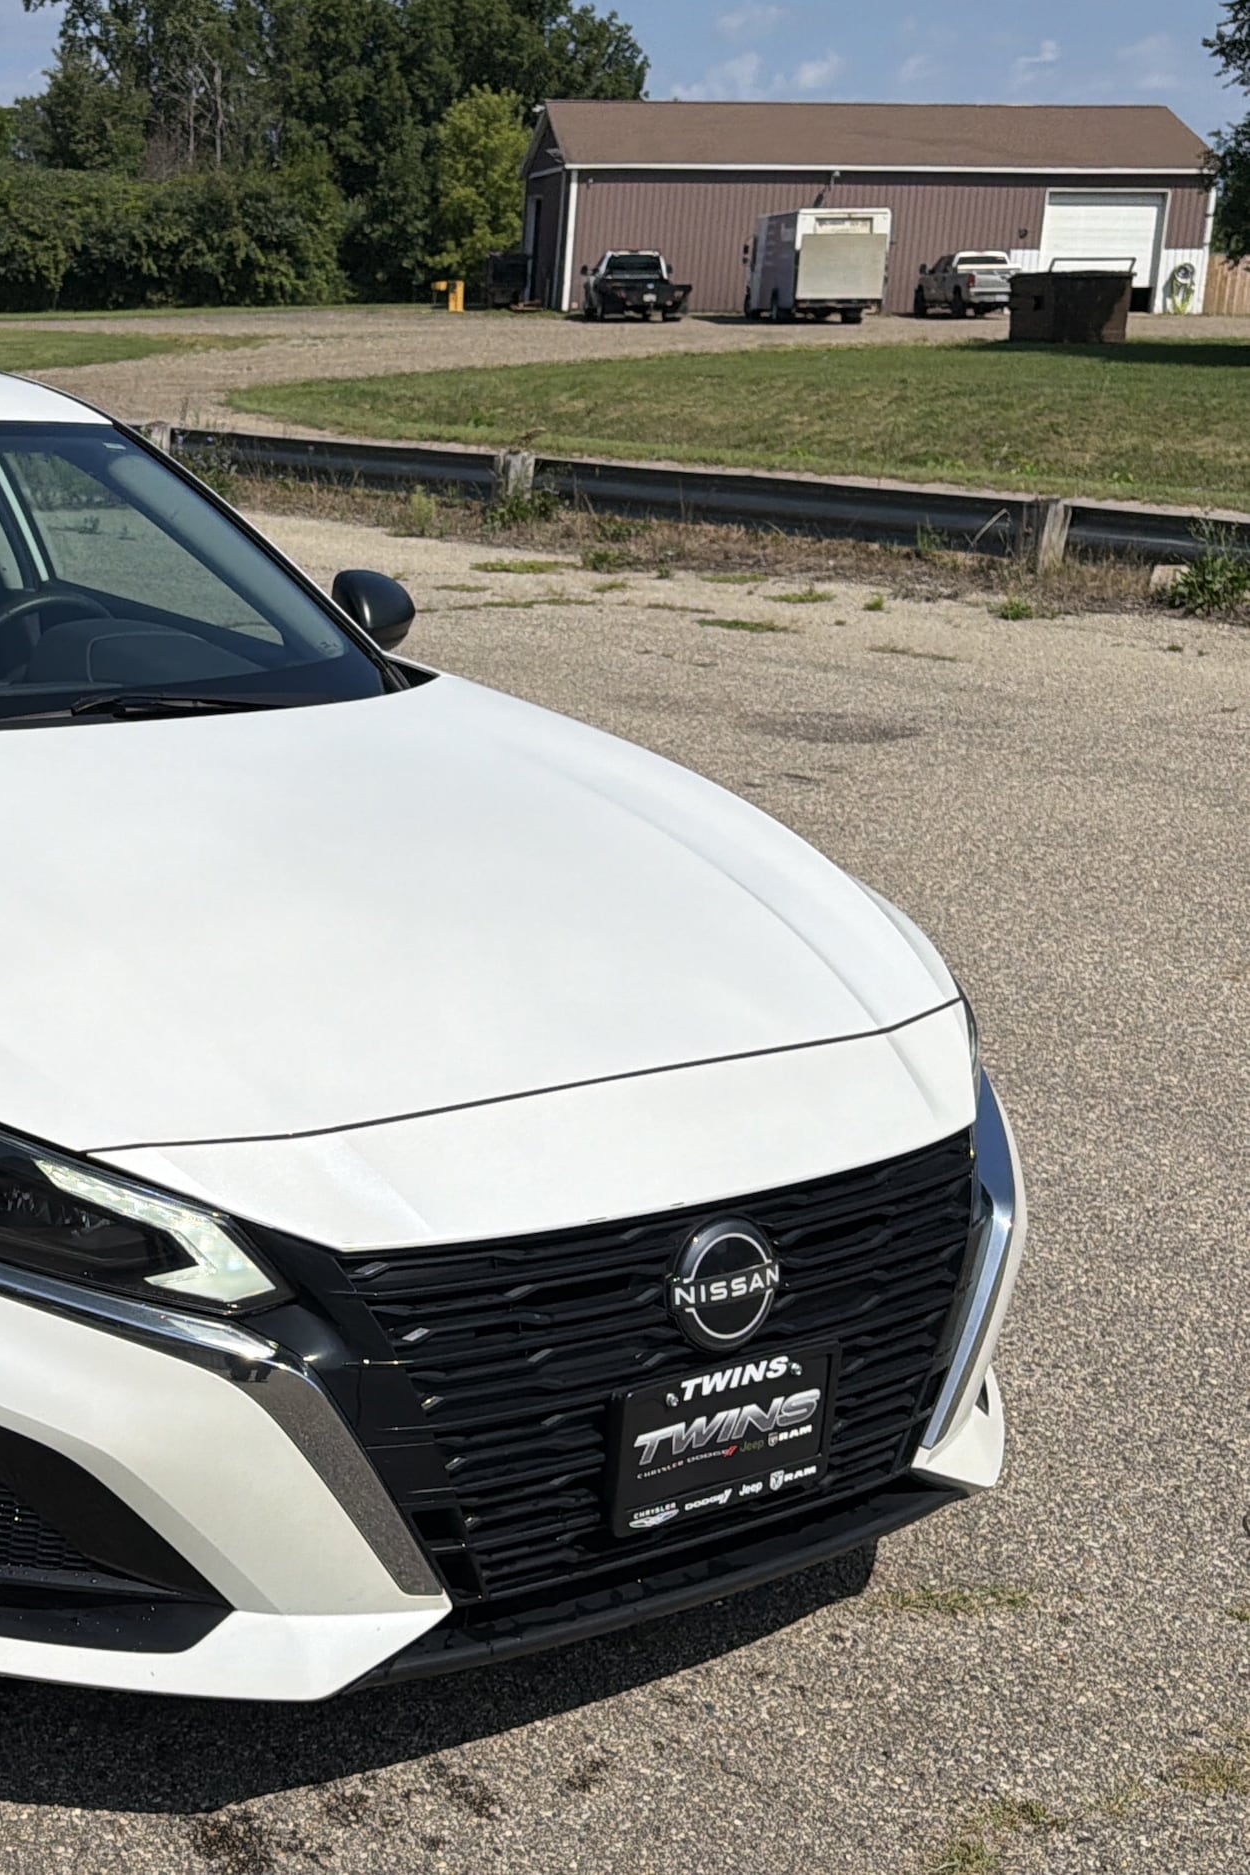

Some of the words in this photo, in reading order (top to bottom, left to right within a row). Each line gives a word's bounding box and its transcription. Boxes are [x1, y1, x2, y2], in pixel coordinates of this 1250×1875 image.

[675, 1264, 779, 1306] NISSAN
[680, 1356, 789, 1401] TWINS
[634, 1388, 821, 1466] TWINS
[637, 1460, 684, 1479] CHRYSLER
[740, 1440, 765, 1452] Jeep
[779, 1424, 813, 1442] RAM
[633, 1502, 677, 1519] CHRYSLER
[739, 1481, 763, 1496] Jeep
[784, 1465, 817, 1482] RAM
